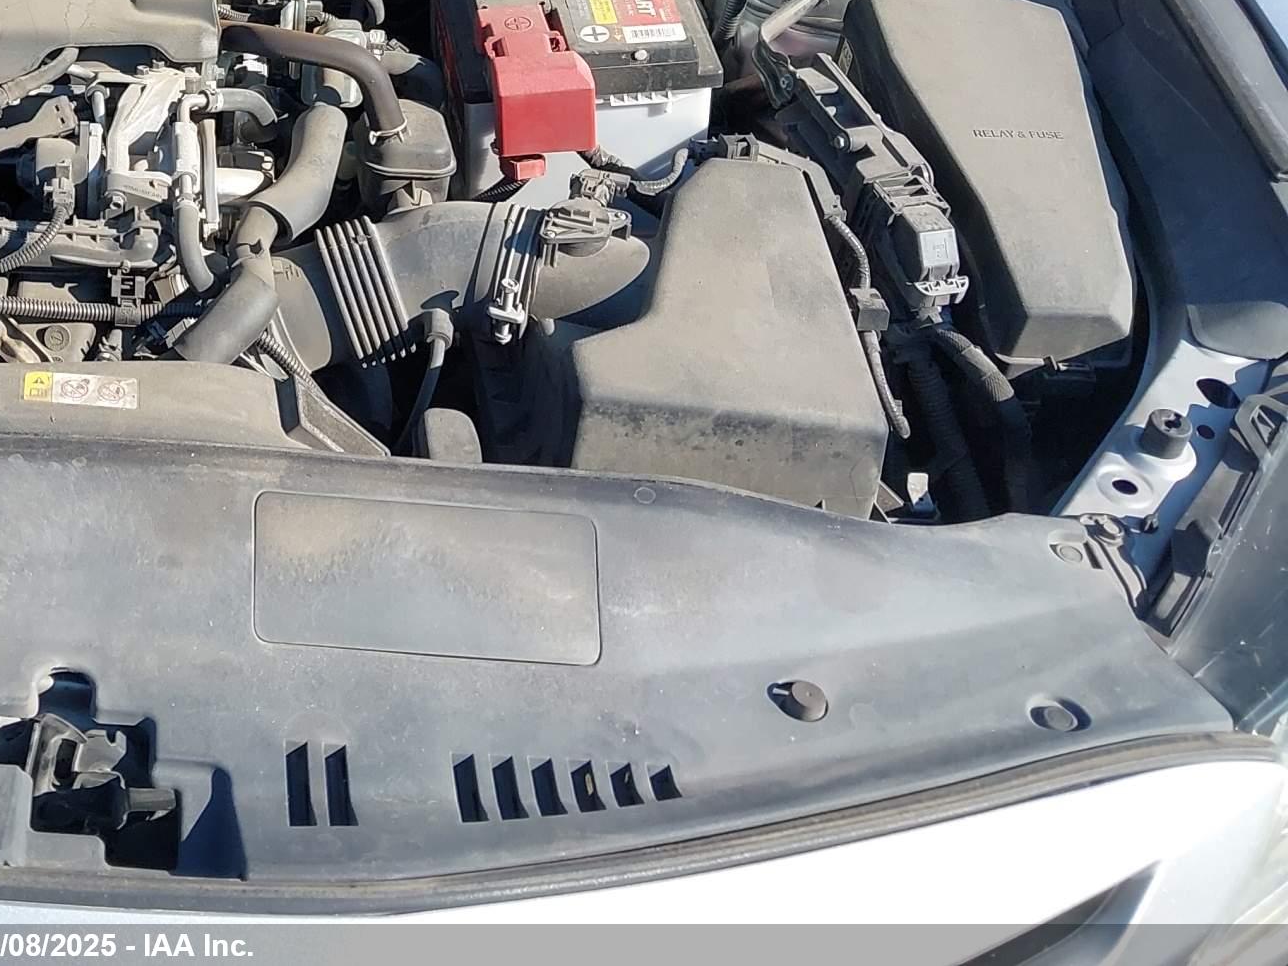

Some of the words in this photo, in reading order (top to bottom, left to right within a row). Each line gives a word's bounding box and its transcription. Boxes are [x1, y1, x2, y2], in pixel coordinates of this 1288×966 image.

[972, 129, 1014, 139] RELAY
[1017, 130, 1027, 139] &
[1028, 130, 1064, 140] FUSE
